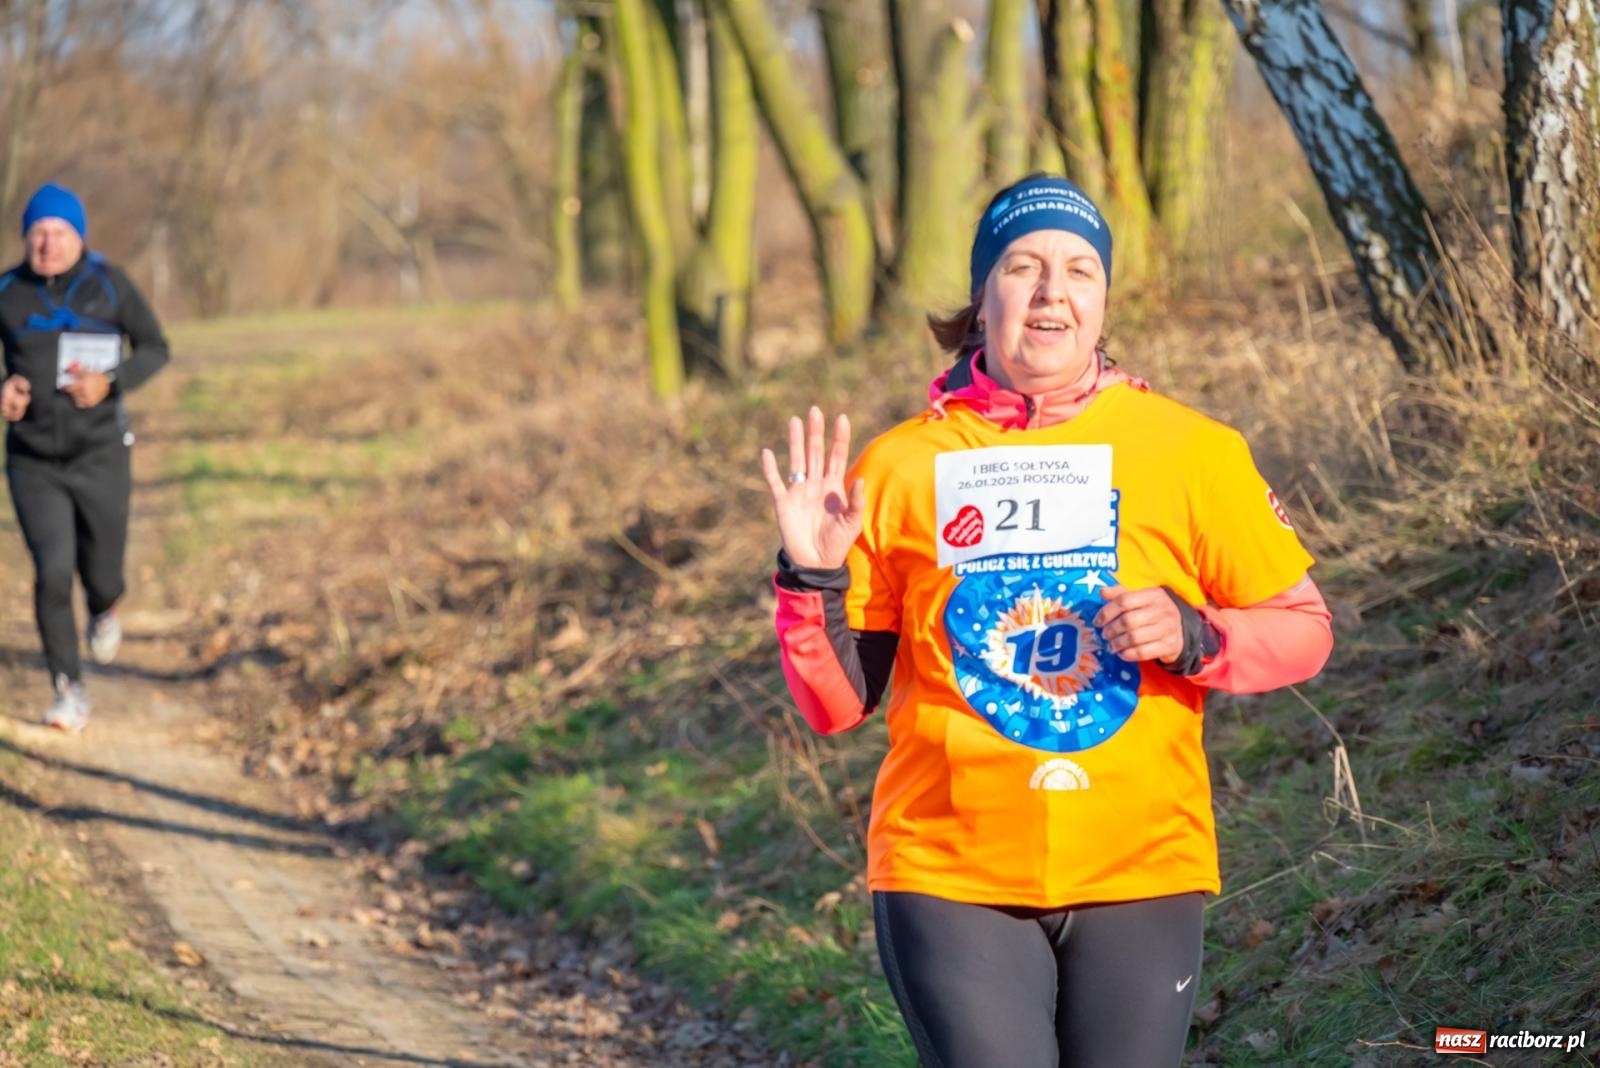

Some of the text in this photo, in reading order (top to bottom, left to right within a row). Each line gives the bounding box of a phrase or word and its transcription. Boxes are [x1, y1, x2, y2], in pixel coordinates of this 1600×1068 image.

[972, 465, 977, 475] I
[980, 462, 1010, 474] BIEG
[957, 473, 1089, 490] 26.01.2025 ROSZKÓW
[995, 498, 1046, 532] 21
[1007, 556, 1031, 571] SIĘ
[1032, 555, 1041, 569] Z
[1042, 552, 1117, 570] CUKRZYCĄ
[1006, 623, 1079, 675] 19
